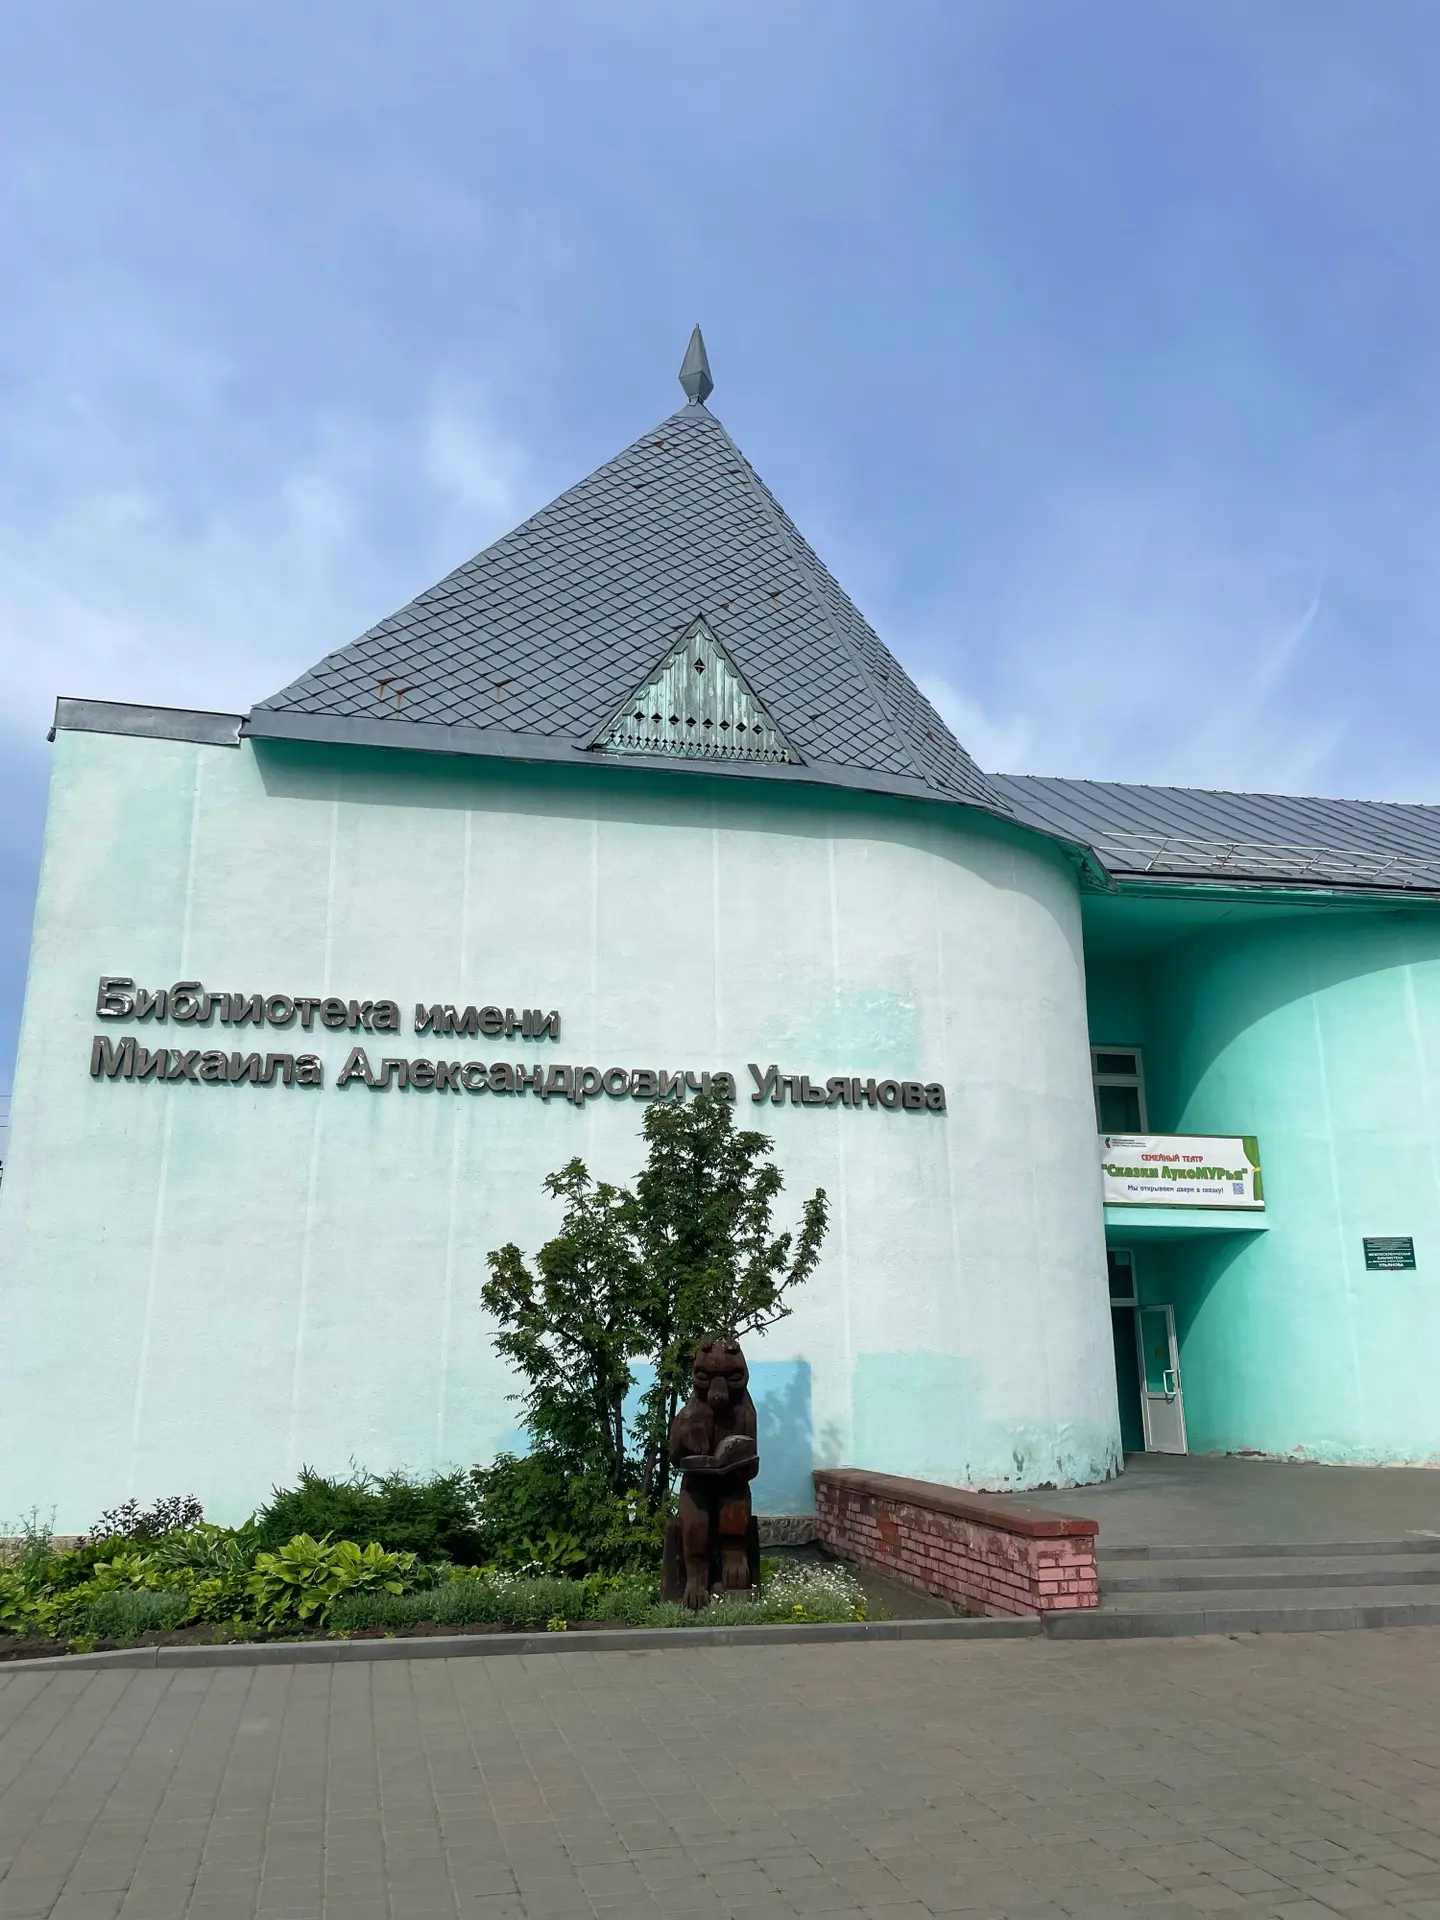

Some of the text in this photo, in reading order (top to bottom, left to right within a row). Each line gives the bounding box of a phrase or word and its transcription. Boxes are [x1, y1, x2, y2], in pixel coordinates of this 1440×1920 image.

[95, 975, 560, 1038] Библиотека имени
[89, 1035, 947, 1110] Михаила Александровича Ульянова
[1141, 1153, 1204, 1163] СЕМЕЙНЫЙ ТЕАТР
[1101, 1163, 1159, 1179] "Сказки
[1140, 1185, 1175, 1193] открываем
